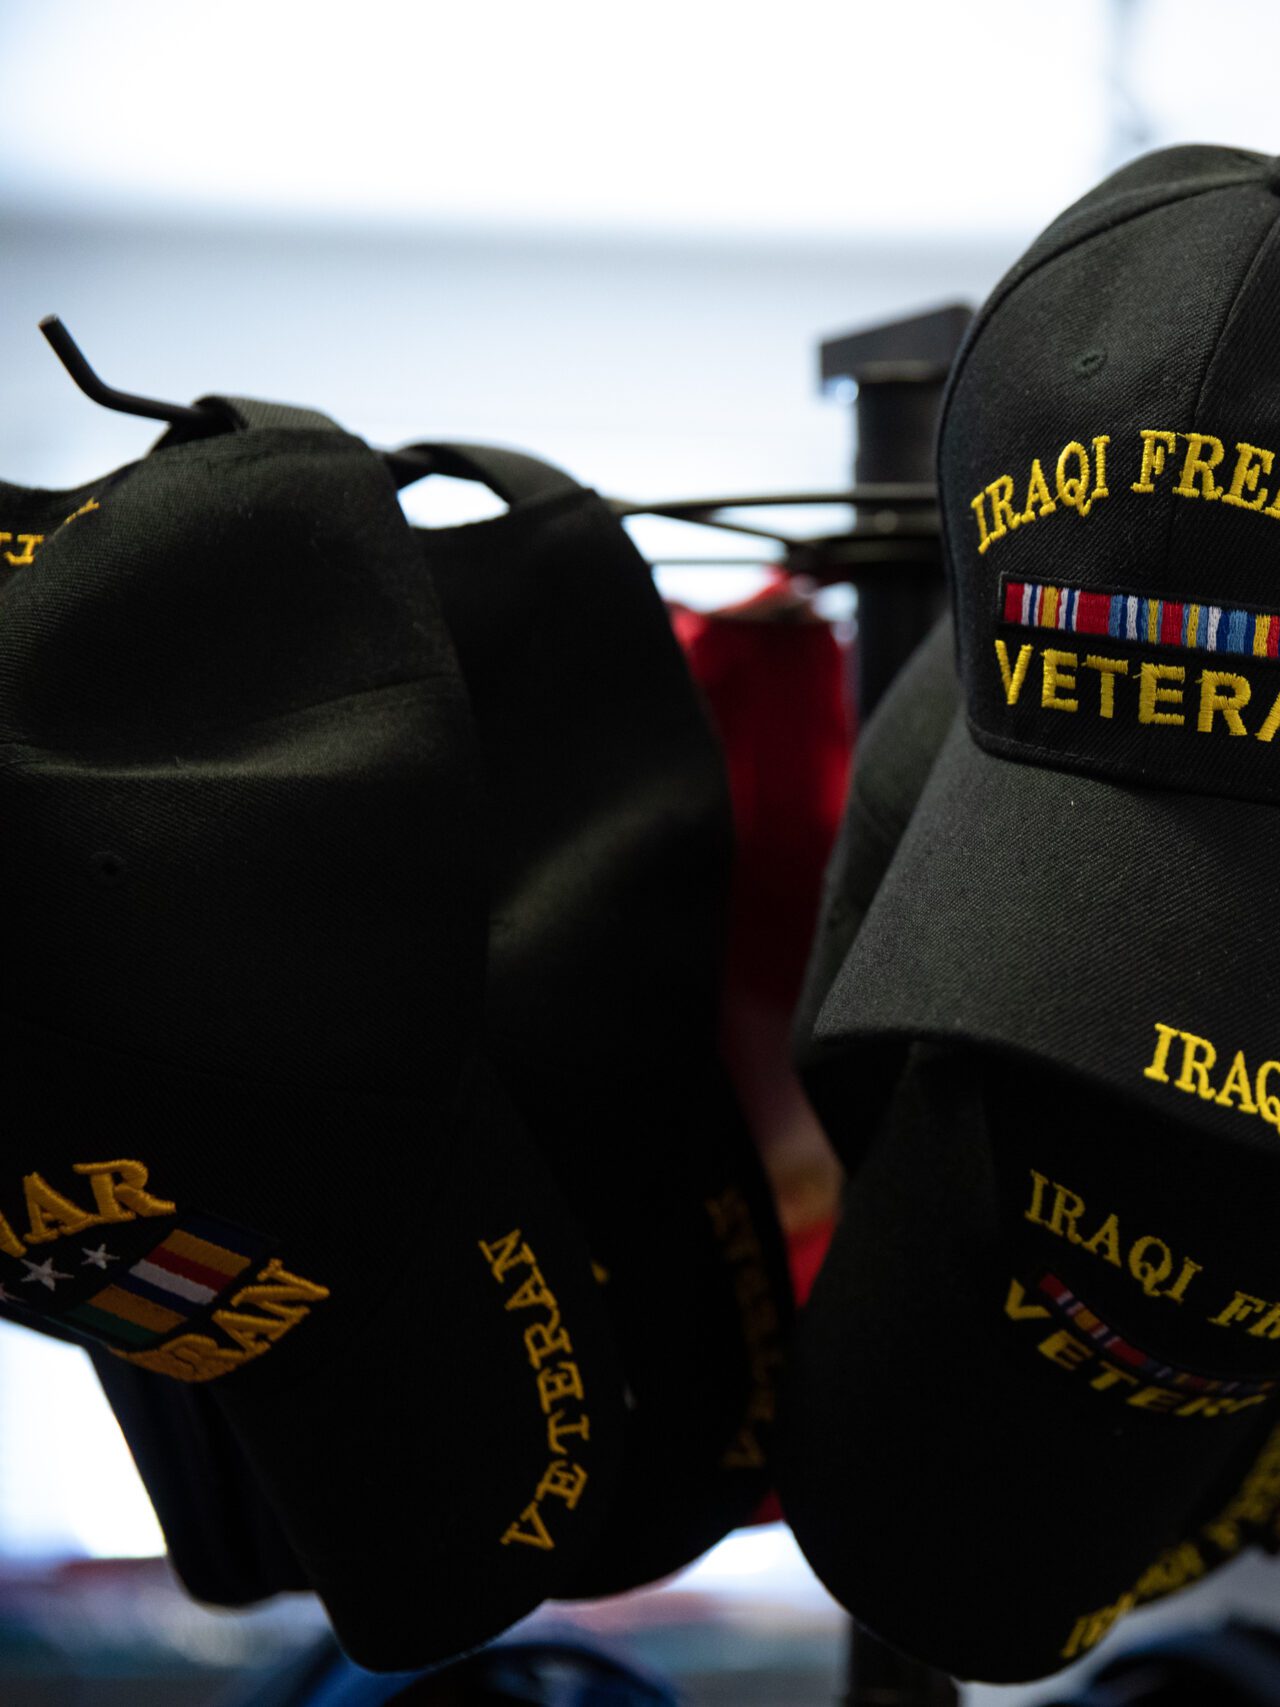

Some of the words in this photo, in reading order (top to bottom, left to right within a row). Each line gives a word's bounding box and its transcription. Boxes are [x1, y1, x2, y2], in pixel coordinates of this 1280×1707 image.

[970, 434, 1111, 555] IRAQI
[1023, 1167, 1204, 1307] IRAQI
[478, 1228, 590, 1552] VETERAN
